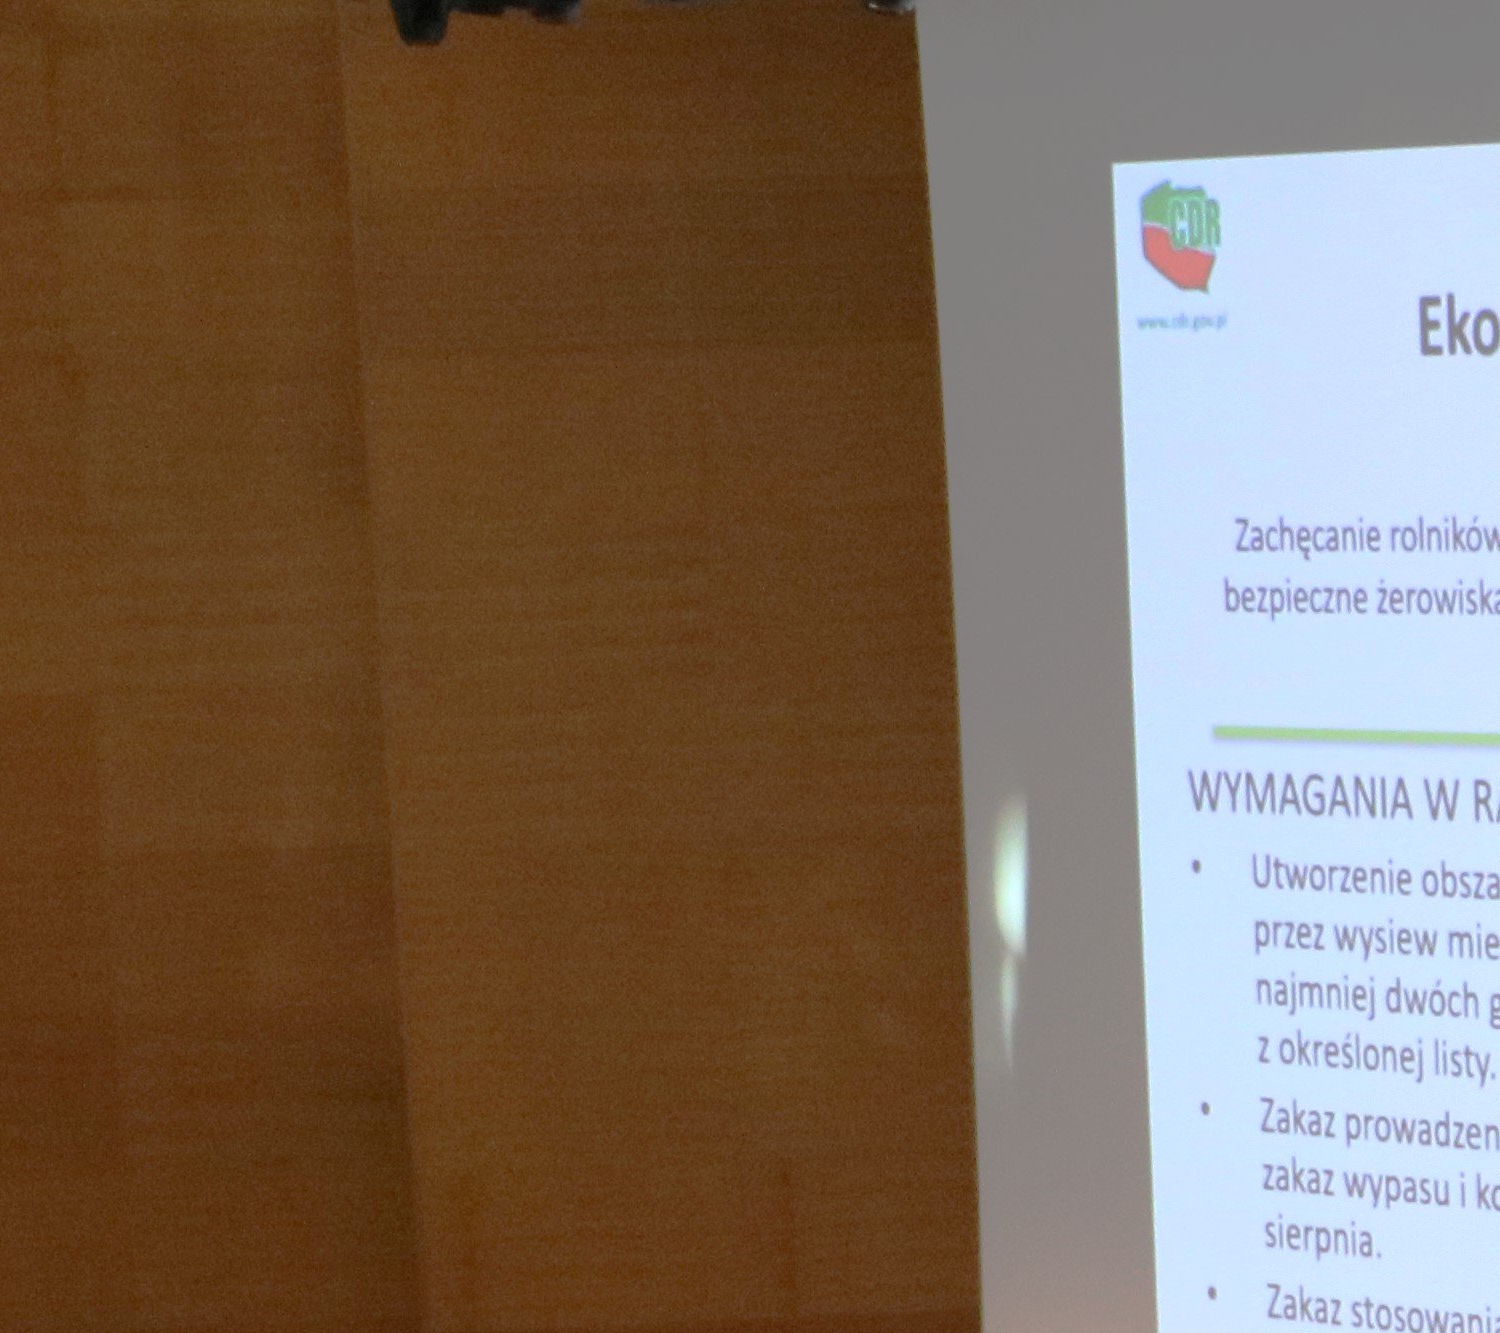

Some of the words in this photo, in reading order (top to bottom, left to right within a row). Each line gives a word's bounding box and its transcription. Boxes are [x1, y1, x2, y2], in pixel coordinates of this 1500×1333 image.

[1169, 198, 1221, 249] CDR
[1235, 516, 1381, 561] Zachęcanie
[1224, 577, 1368, 621] bezpieczne
[1188, 769, 1413, 819] WYMAGANIA
[1423, 777, 1460, 821] W
[1252, 853, 1412, 895] Utworzenie
[1254, 919, 1325, 954] przez
[1333, 918, 1438, 961] wysiew
[1256, 971, 1375, 1021] najmniej
[1385, 976, 1479, 1018] dwóch
[1279, 1029, 1423, 1083] określonej
[1434, 1038, 1496, 1087] listy.
[1260, 1096, 1336, 1138] Zakaz
[1263, 1156, 1334, 1196] zakaz
[1343, 1171, 1450, 1209] wypasu
[1265, 1213, 1381, 1261] sierpnia.
[1267, 1282, 1342, 1326] Zakaz
